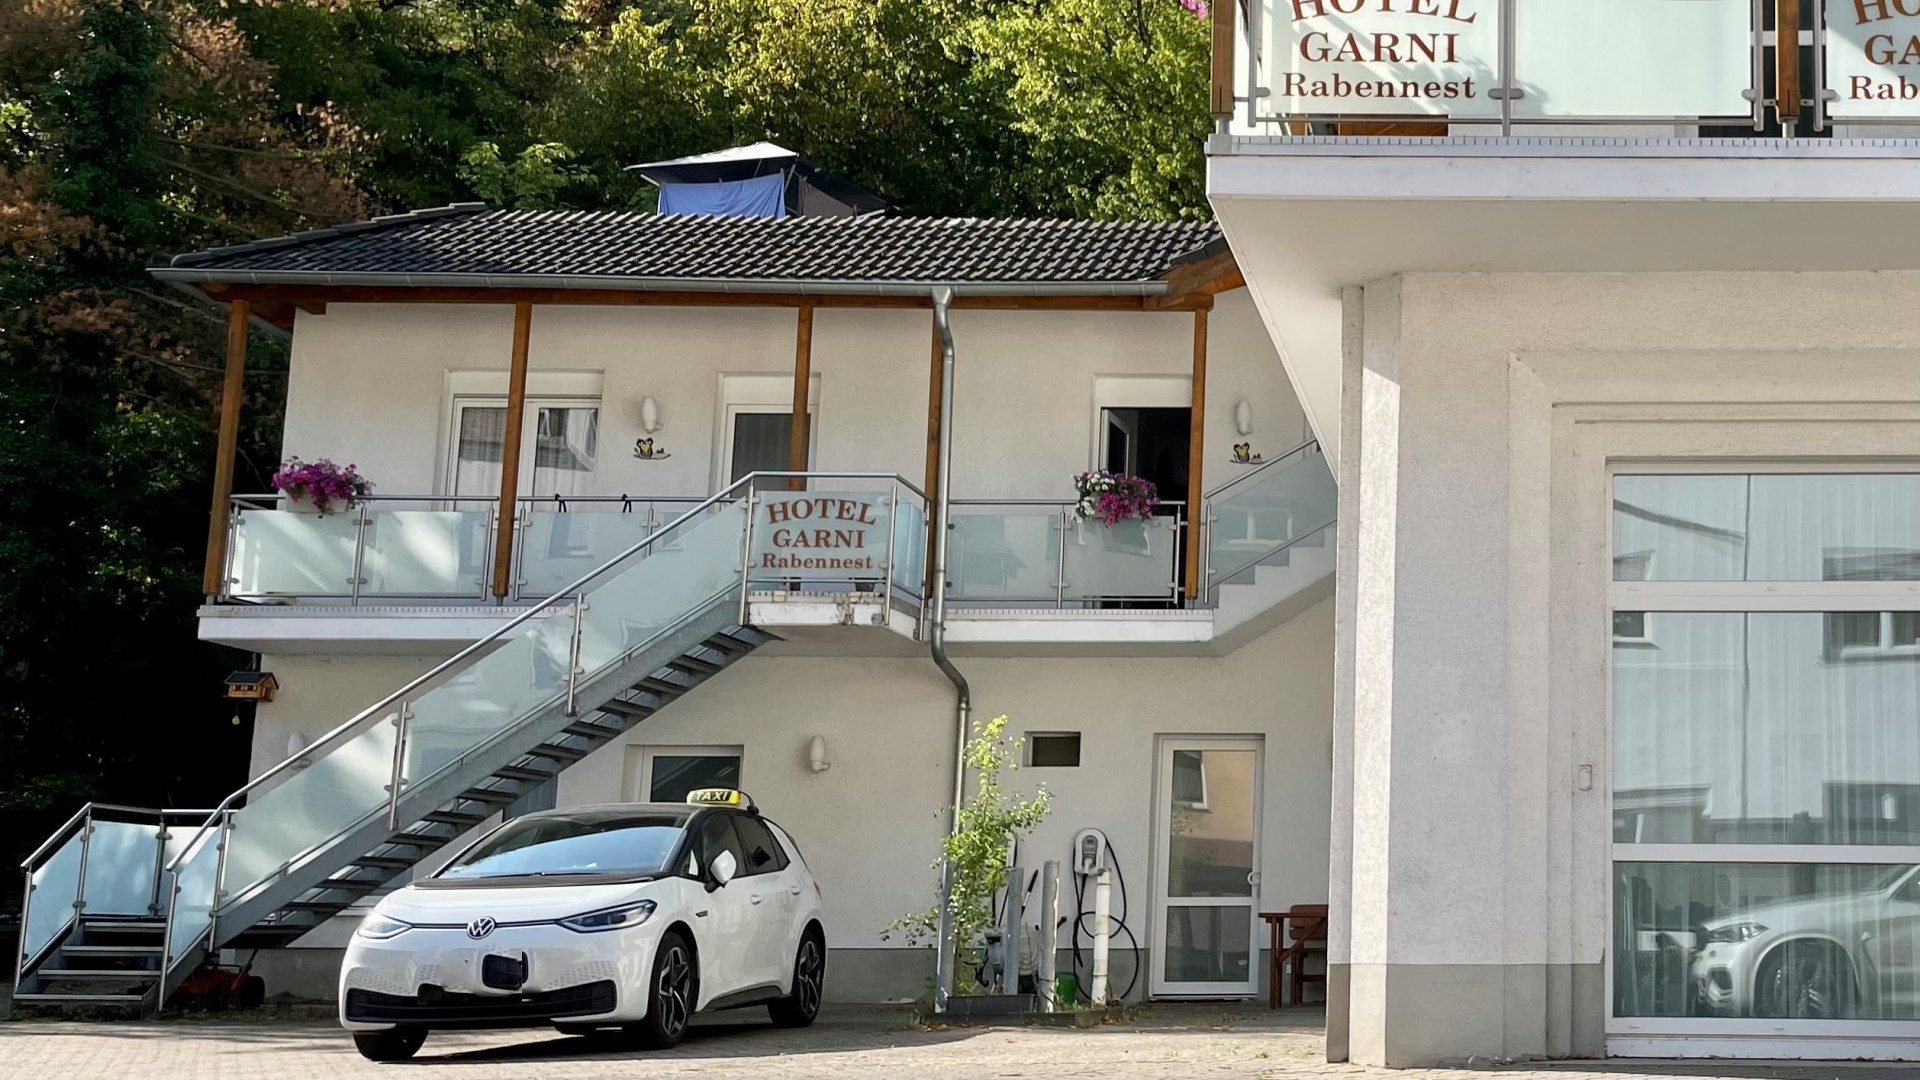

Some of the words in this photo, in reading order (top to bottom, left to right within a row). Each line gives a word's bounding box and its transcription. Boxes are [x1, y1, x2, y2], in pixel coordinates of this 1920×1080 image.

[1299, 31, 1460, 63] GARNI
[1281, 72, 1476, 98] Rabennest
[766, 499, 876, 526] HOTEL
[772, 529, 866, 548] GARNI
[762, 553, 873, 569] Rabennest
[696, 791, 728, 801] TAXI
